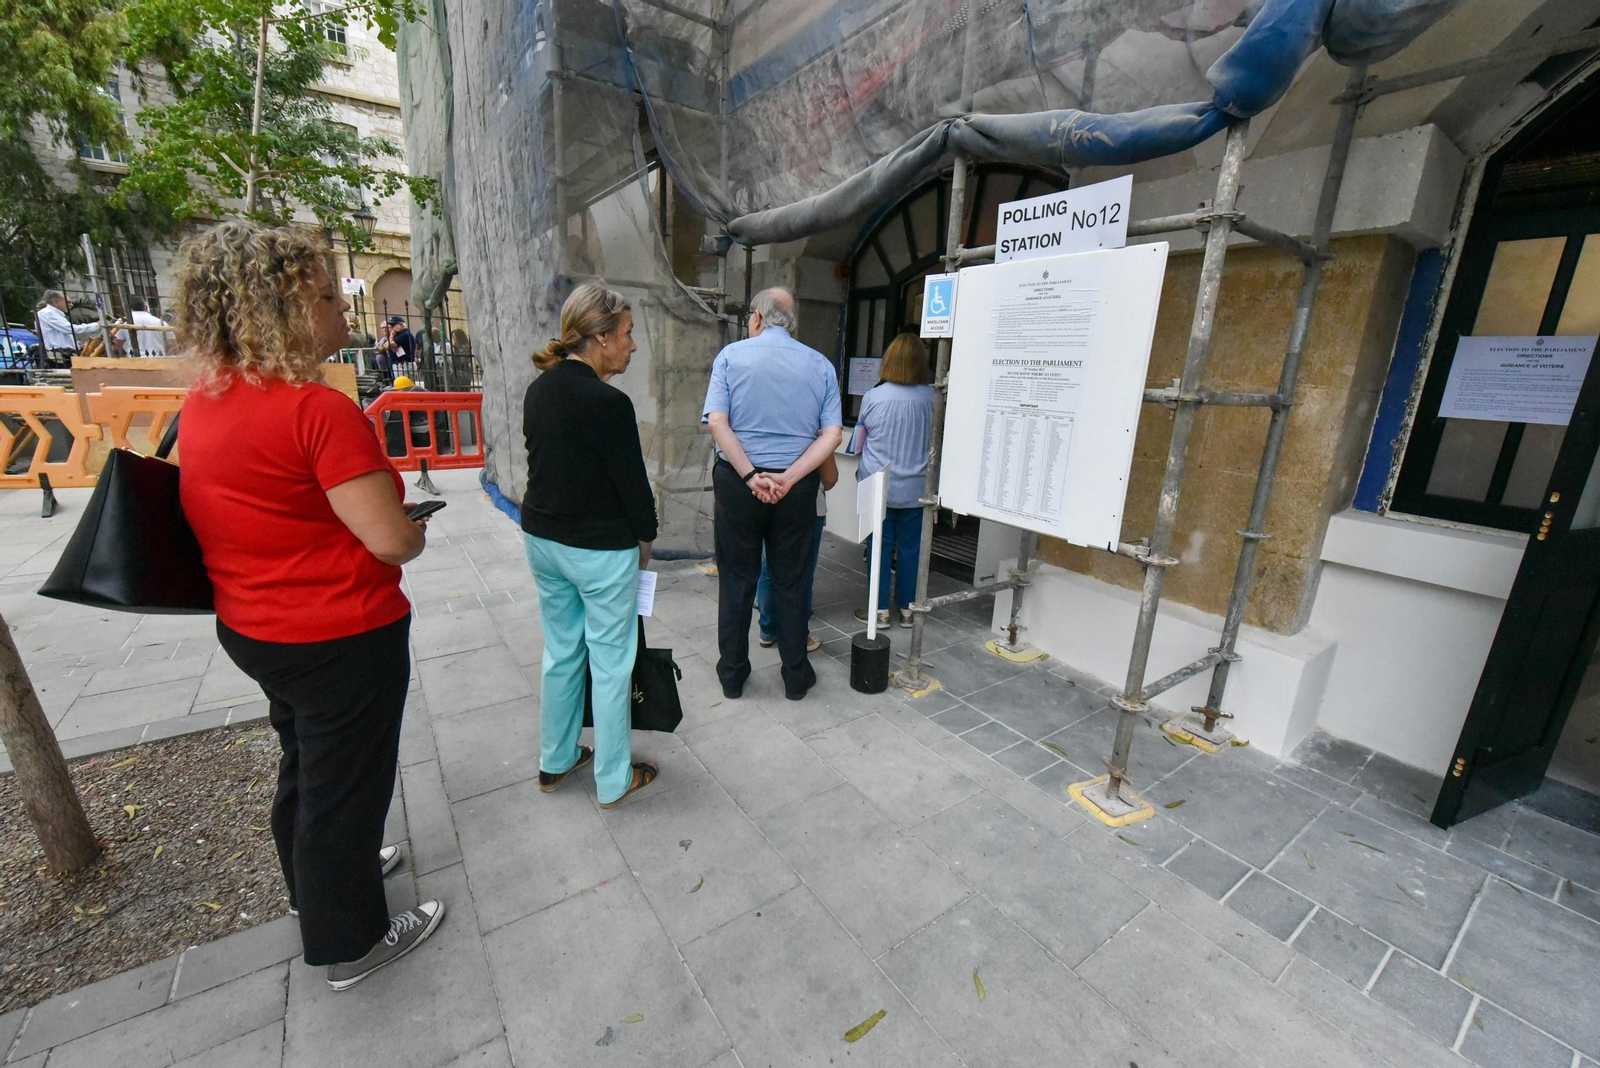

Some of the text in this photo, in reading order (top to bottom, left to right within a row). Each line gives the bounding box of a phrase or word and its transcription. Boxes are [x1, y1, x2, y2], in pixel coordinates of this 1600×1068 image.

[1003, 200, 1068, 225] POLLING
[1000, 231, 1062, 254] STATION
[1042, 359, 1084, 367] PARLIAMENT
